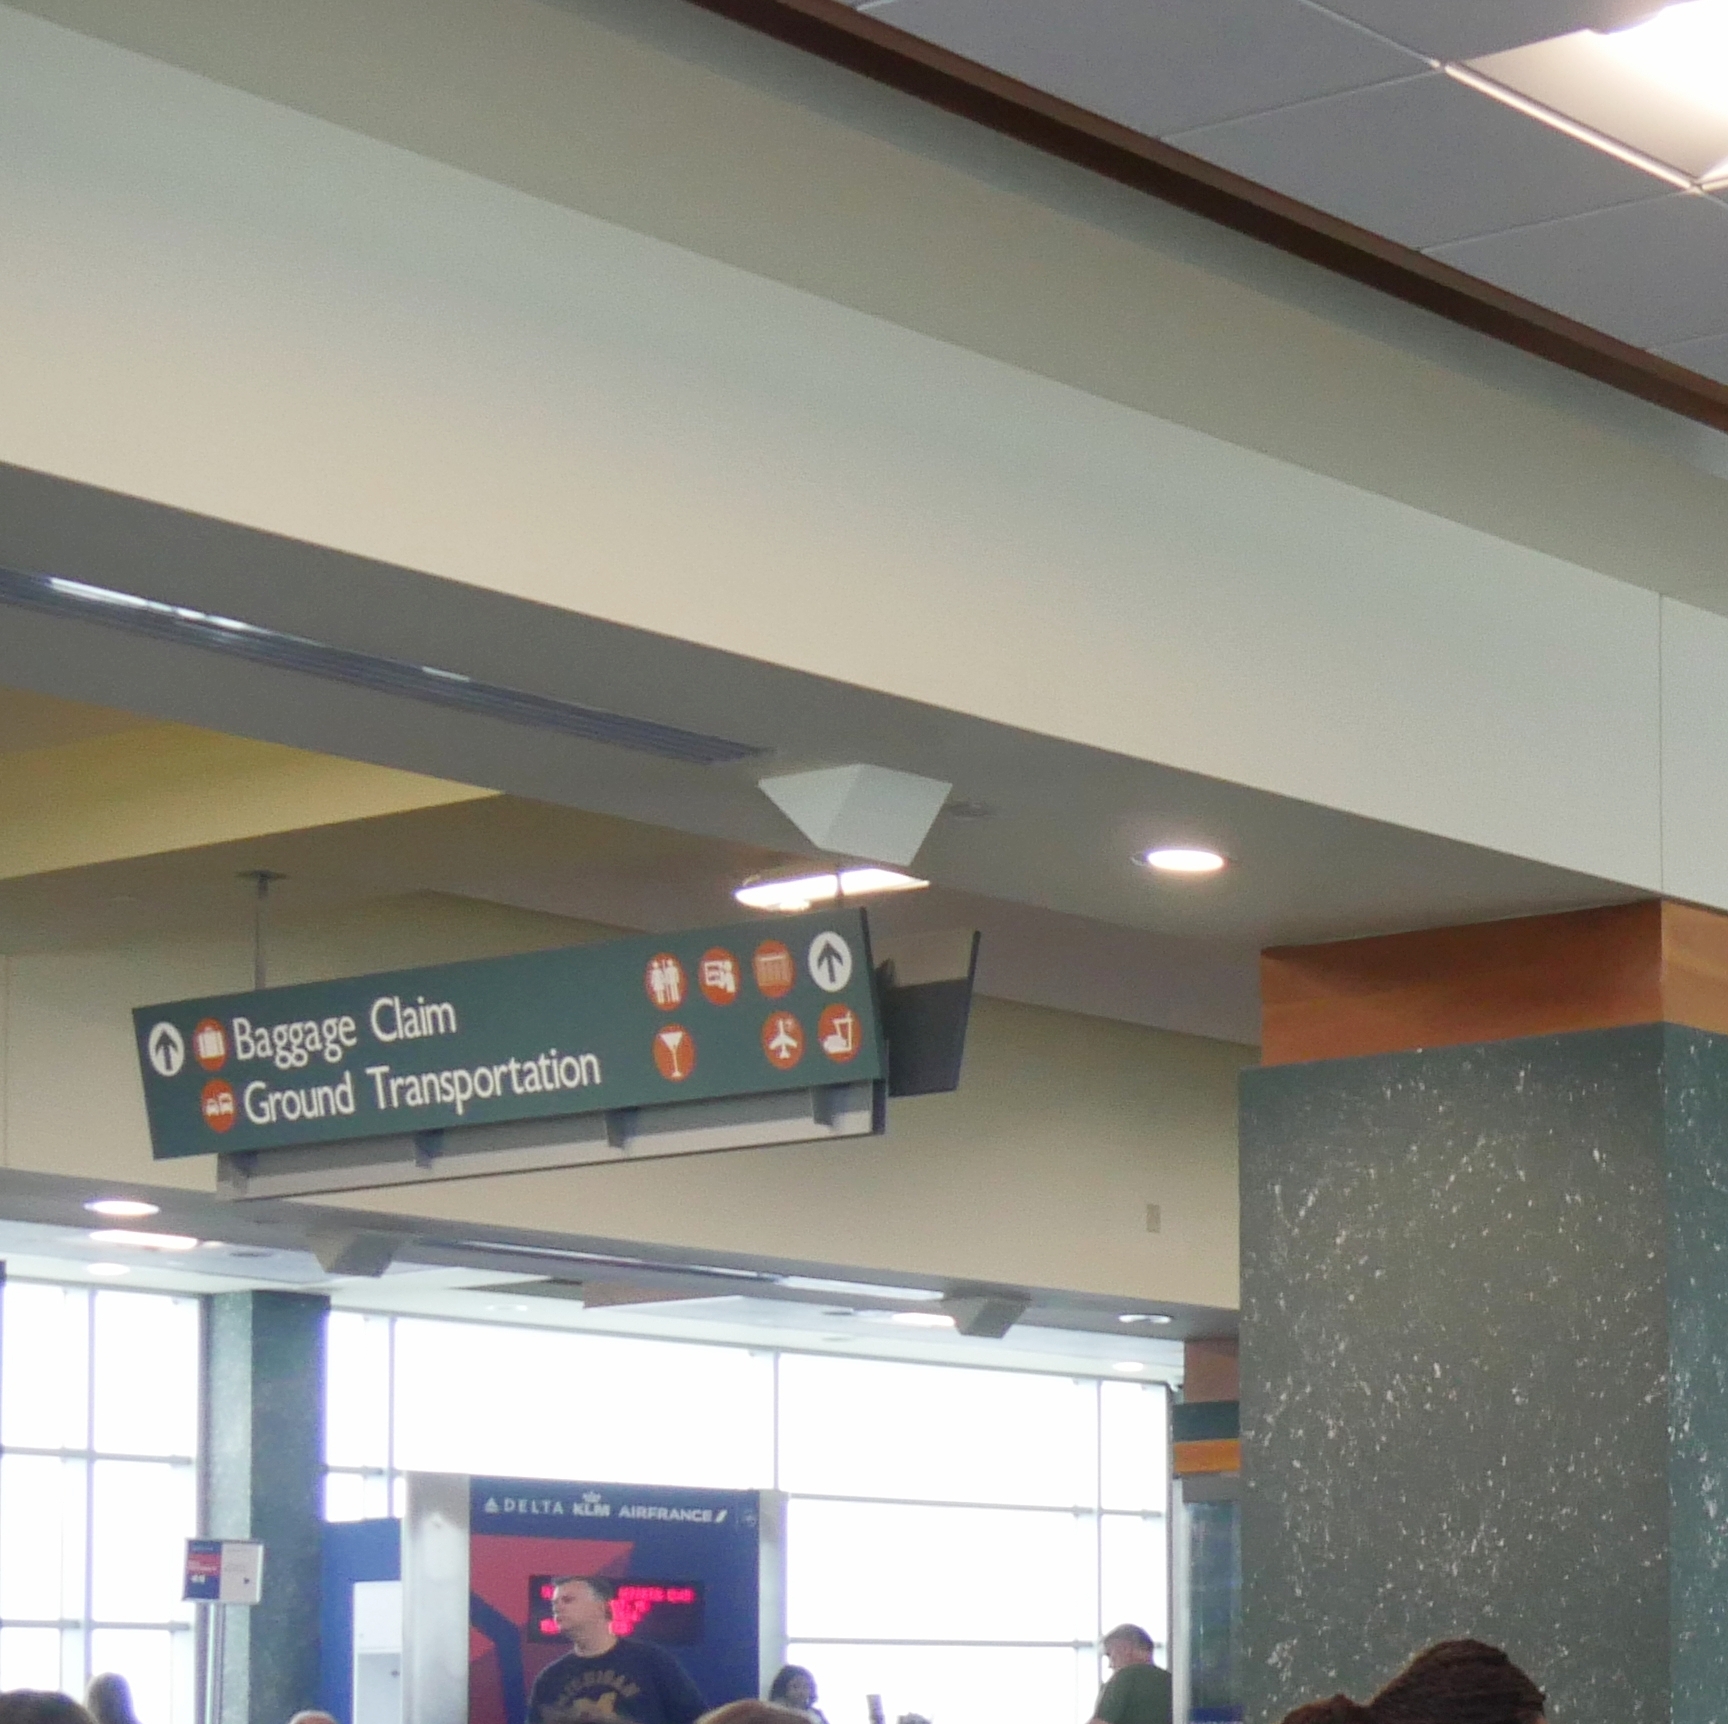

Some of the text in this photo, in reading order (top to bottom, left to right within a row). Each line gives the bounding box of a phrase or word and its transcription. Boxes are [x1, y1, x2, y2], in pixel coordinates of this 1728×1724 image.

[232, 996, 457, 1070] Baggage Claim
[244, 1048, 601, 1125] Ground Transportation
[503, 1497, 712, 1523] DELTA KLM AIRFRANCE
